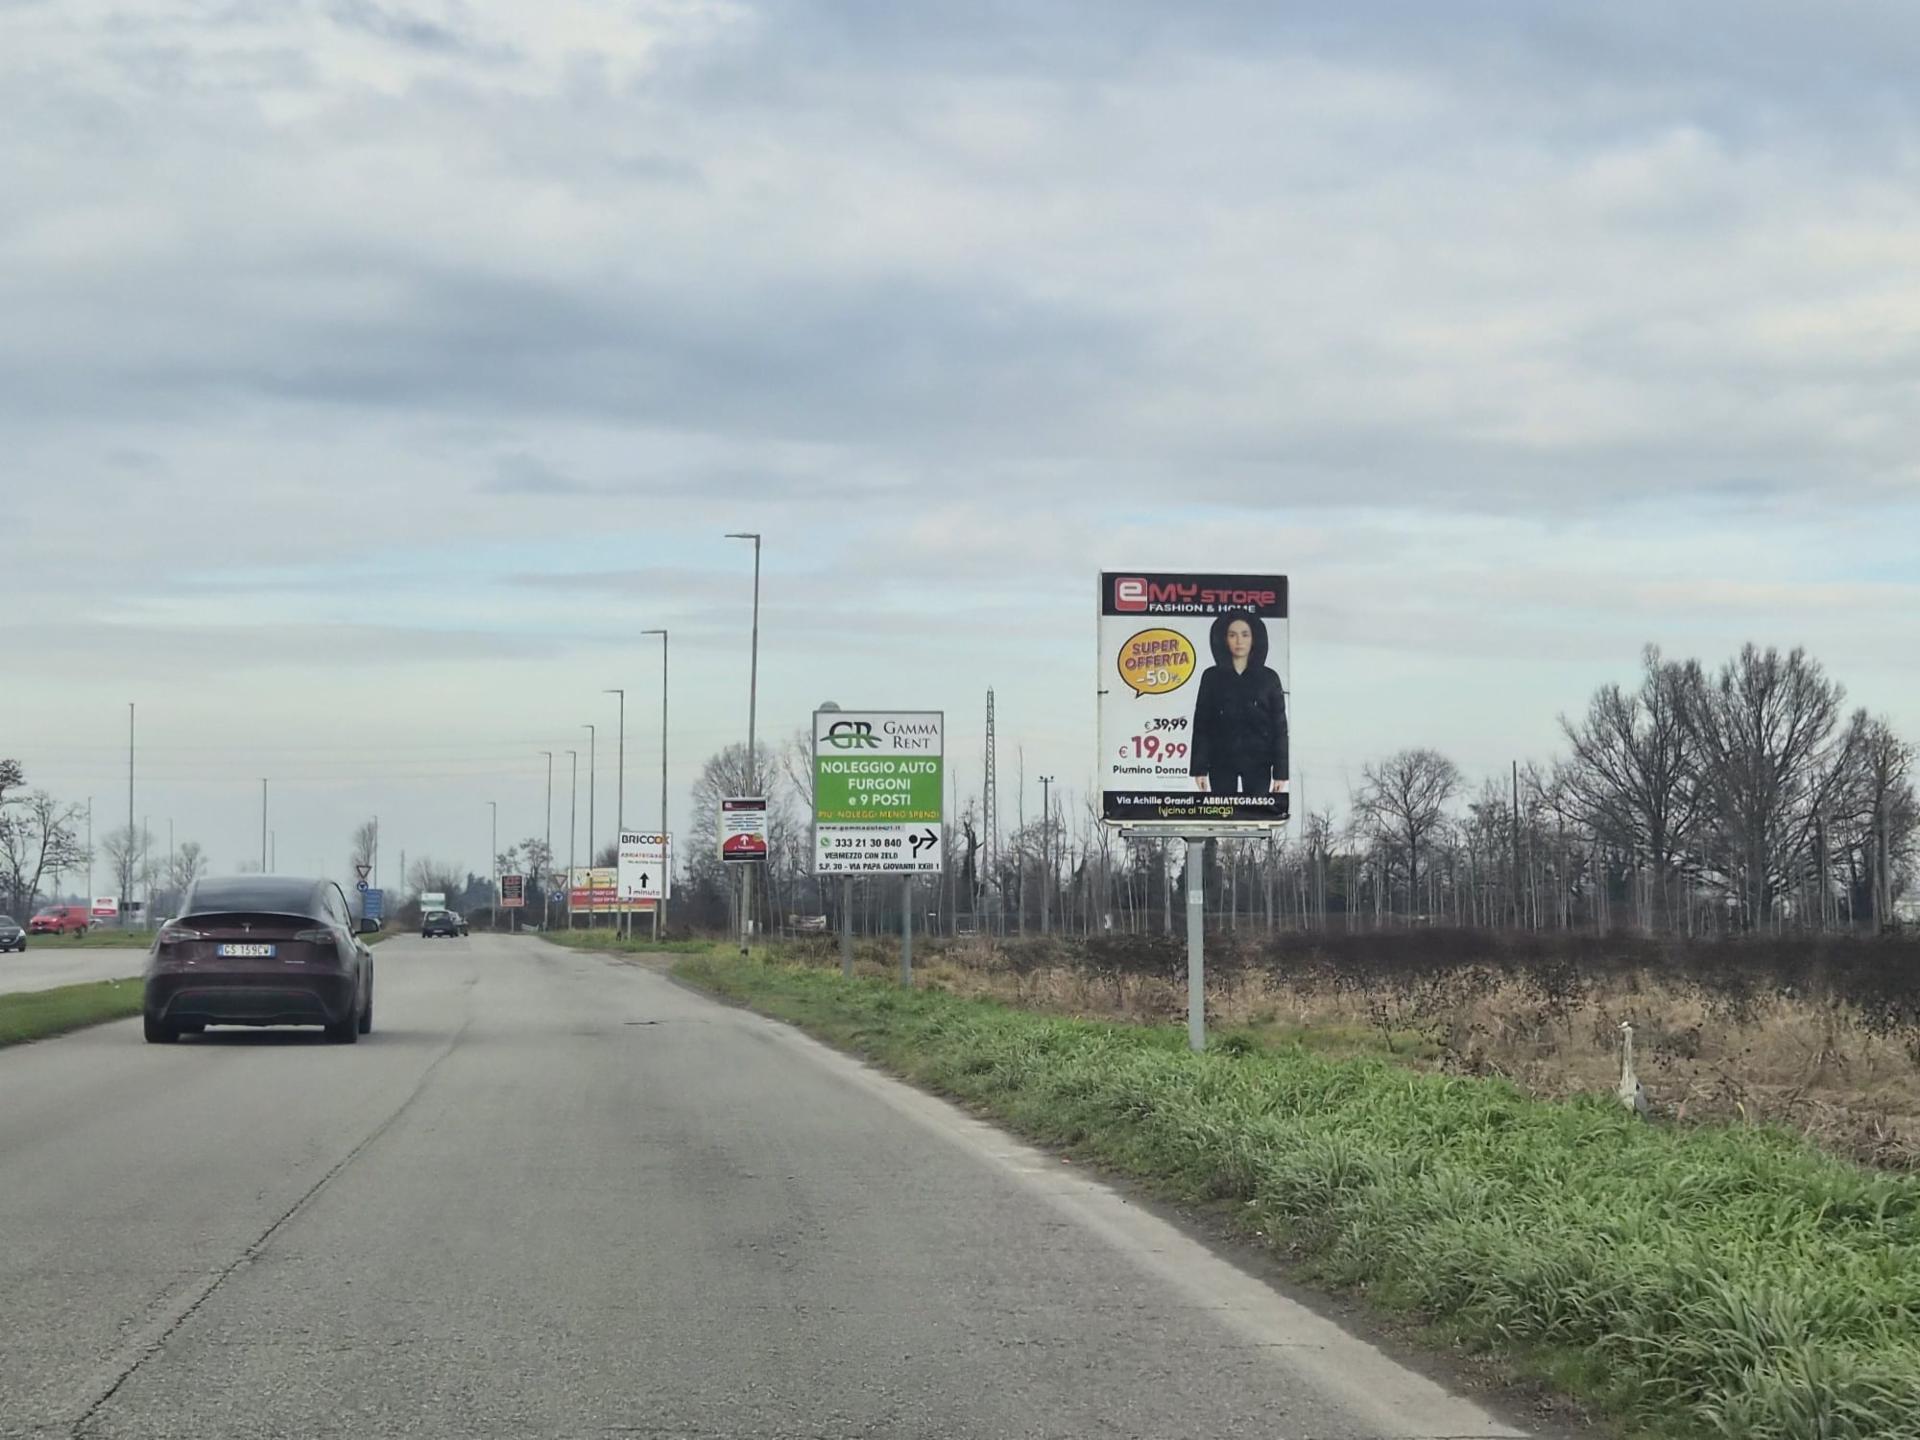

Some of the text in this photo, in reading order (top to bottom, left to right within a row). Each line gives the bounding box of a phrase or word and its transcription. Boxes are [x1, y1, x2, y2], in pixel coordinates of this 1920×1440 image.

[1150, 603, 1203, 612] FASHION
[1207, 604, 1215, 612] &
[1132, 639, 1178, 655] SUPER
[1125, 651, 1189, 670] OFFERTA
[893, 736, 930, 749] RENT
[1119, 735, 1187, 763] € 19,99
[821, 762, 937, 774] NOLEGGIO AUTO
[1113, 764, 1188, 774] Piumino Donna
[848, 778, 911, 790] FURGONI
[848, 794, 911, 806] e 9 POSTI
[1116, 796, 1131, 805] Via
[1133, 796, 1162, 805] Achille
[1164, 796, 1194, 805] Grandi
[1203, 797, 1275, 806] ABBIATEGRASSO
[1188, 806, 1196, 814] al
[835, 839, 902, 847] 333 21 30 840
[628, 885, 632, 895] 1
